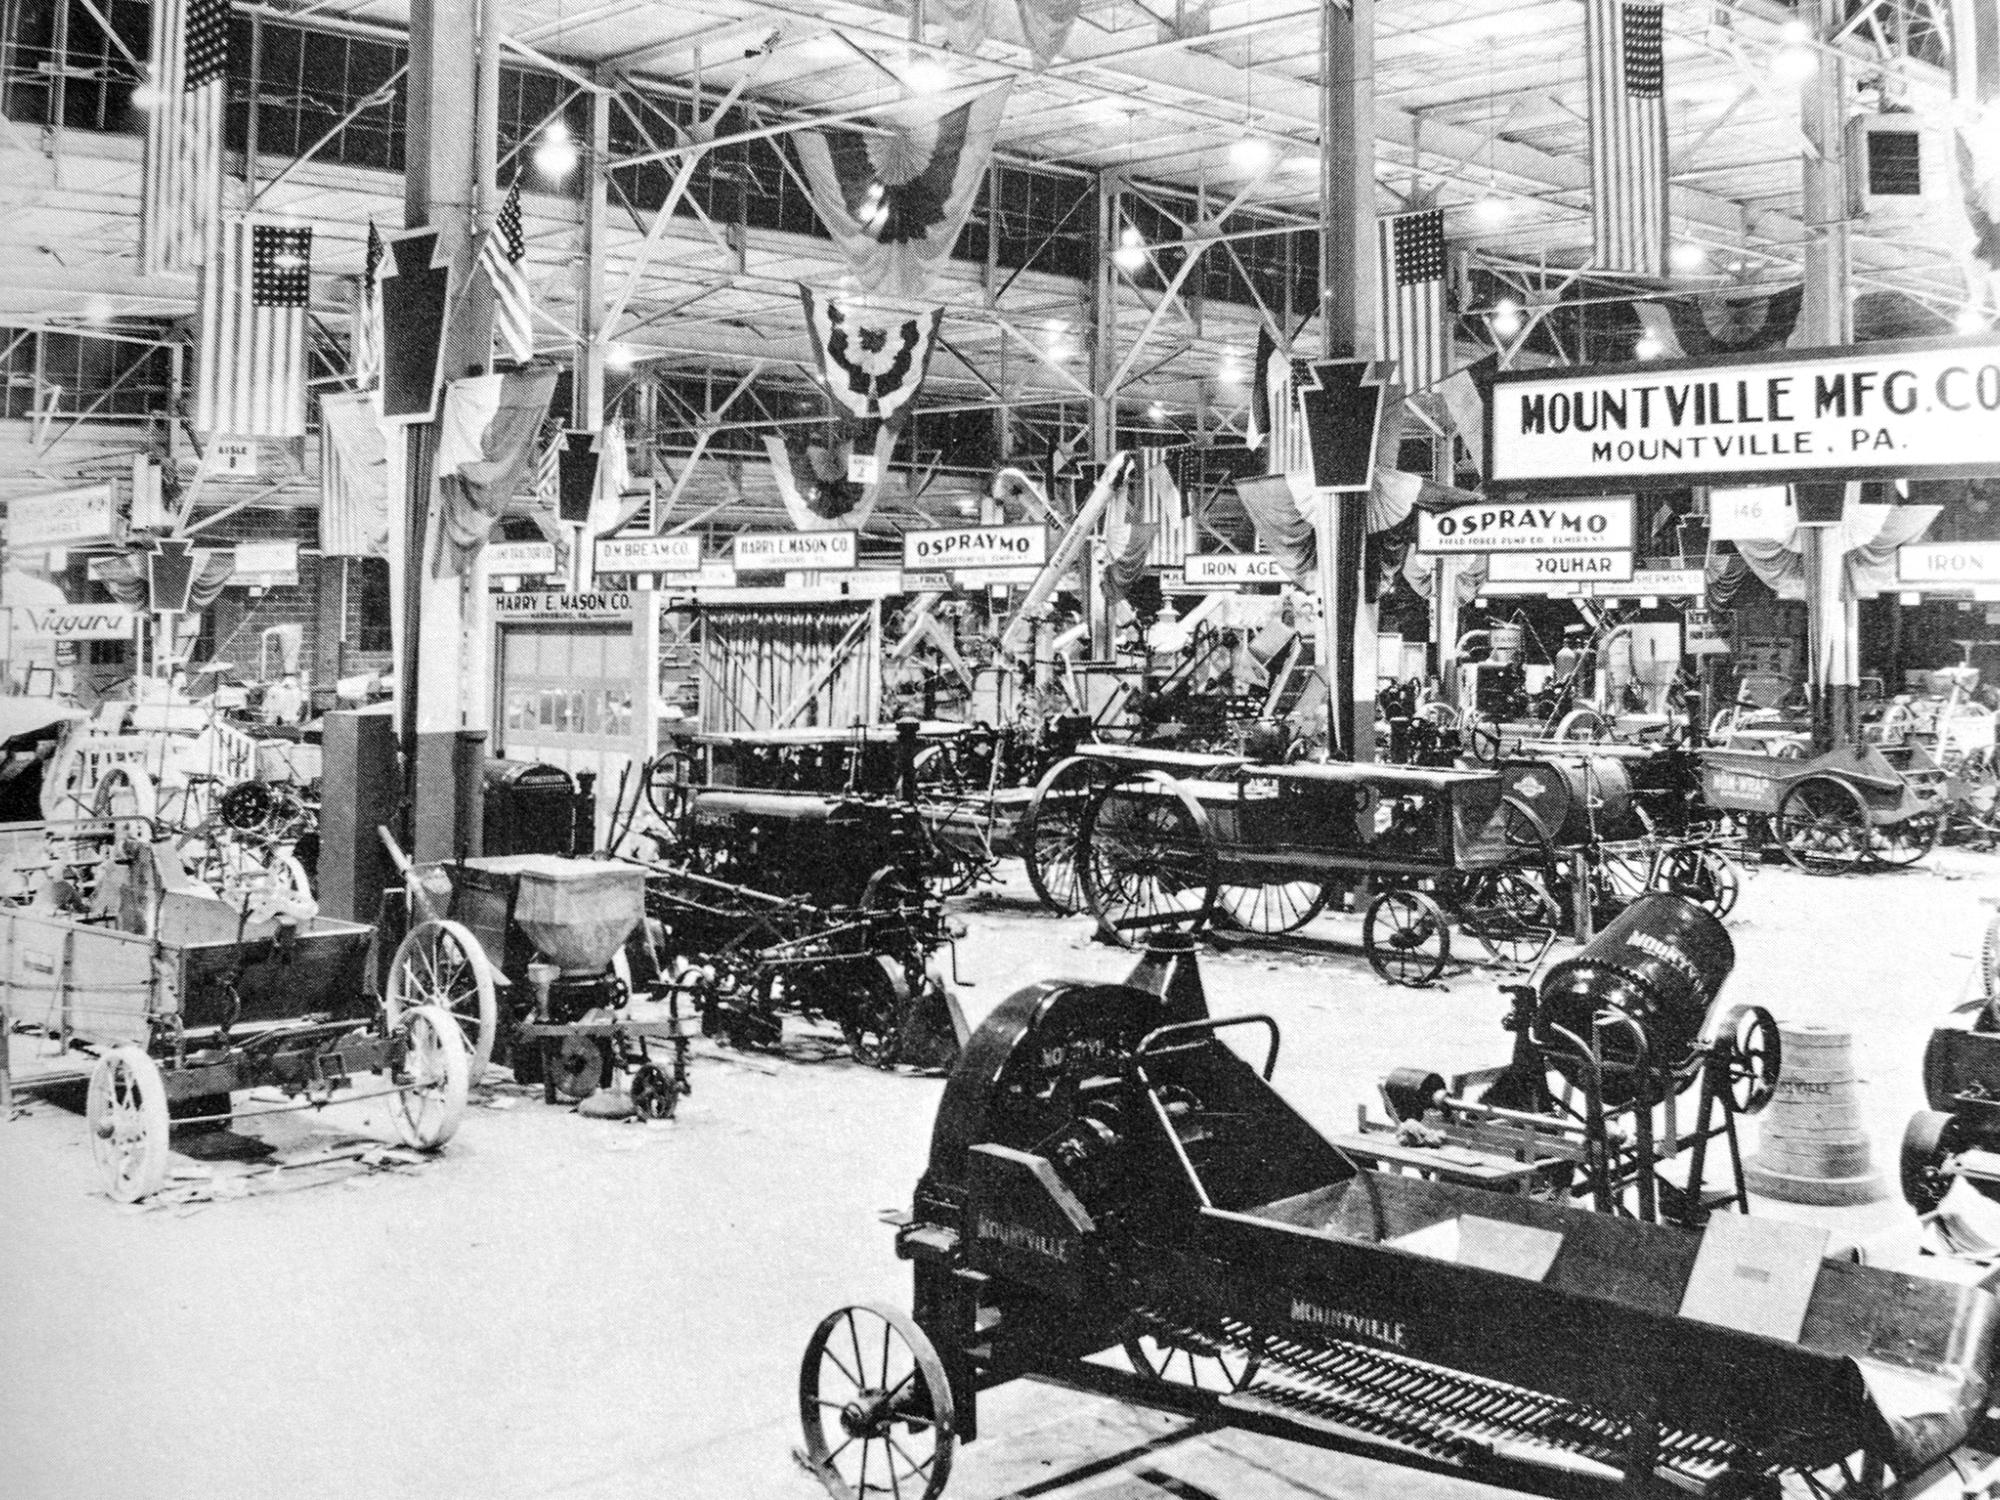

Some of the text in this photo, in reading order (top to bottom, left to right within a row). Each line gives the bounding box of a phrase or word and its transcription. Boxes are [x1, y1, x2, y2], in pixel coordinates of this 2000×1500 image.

[1521, 377, 1795, 435] MOUNTVILLE
[1851, 428, 1909, 452] PA.
[1438, 509, 1608, 536] OSPRAYMO
[789, 538, 827, 553] MASON
[916, 534, 1030, 557] OSPRAYMO
[1202, 561, 1279, 576] IRON AGE
[1927, 554, 1983, 571] IRON
[497, 596, 537, 610] HARRY
[560, 594, 605, 610] MASON
[611, 593, 632, 610] CO.
[13, 607, 123, 635] Niagara
[1290, 1297, 1407, 1350] MOUNTVILLE
